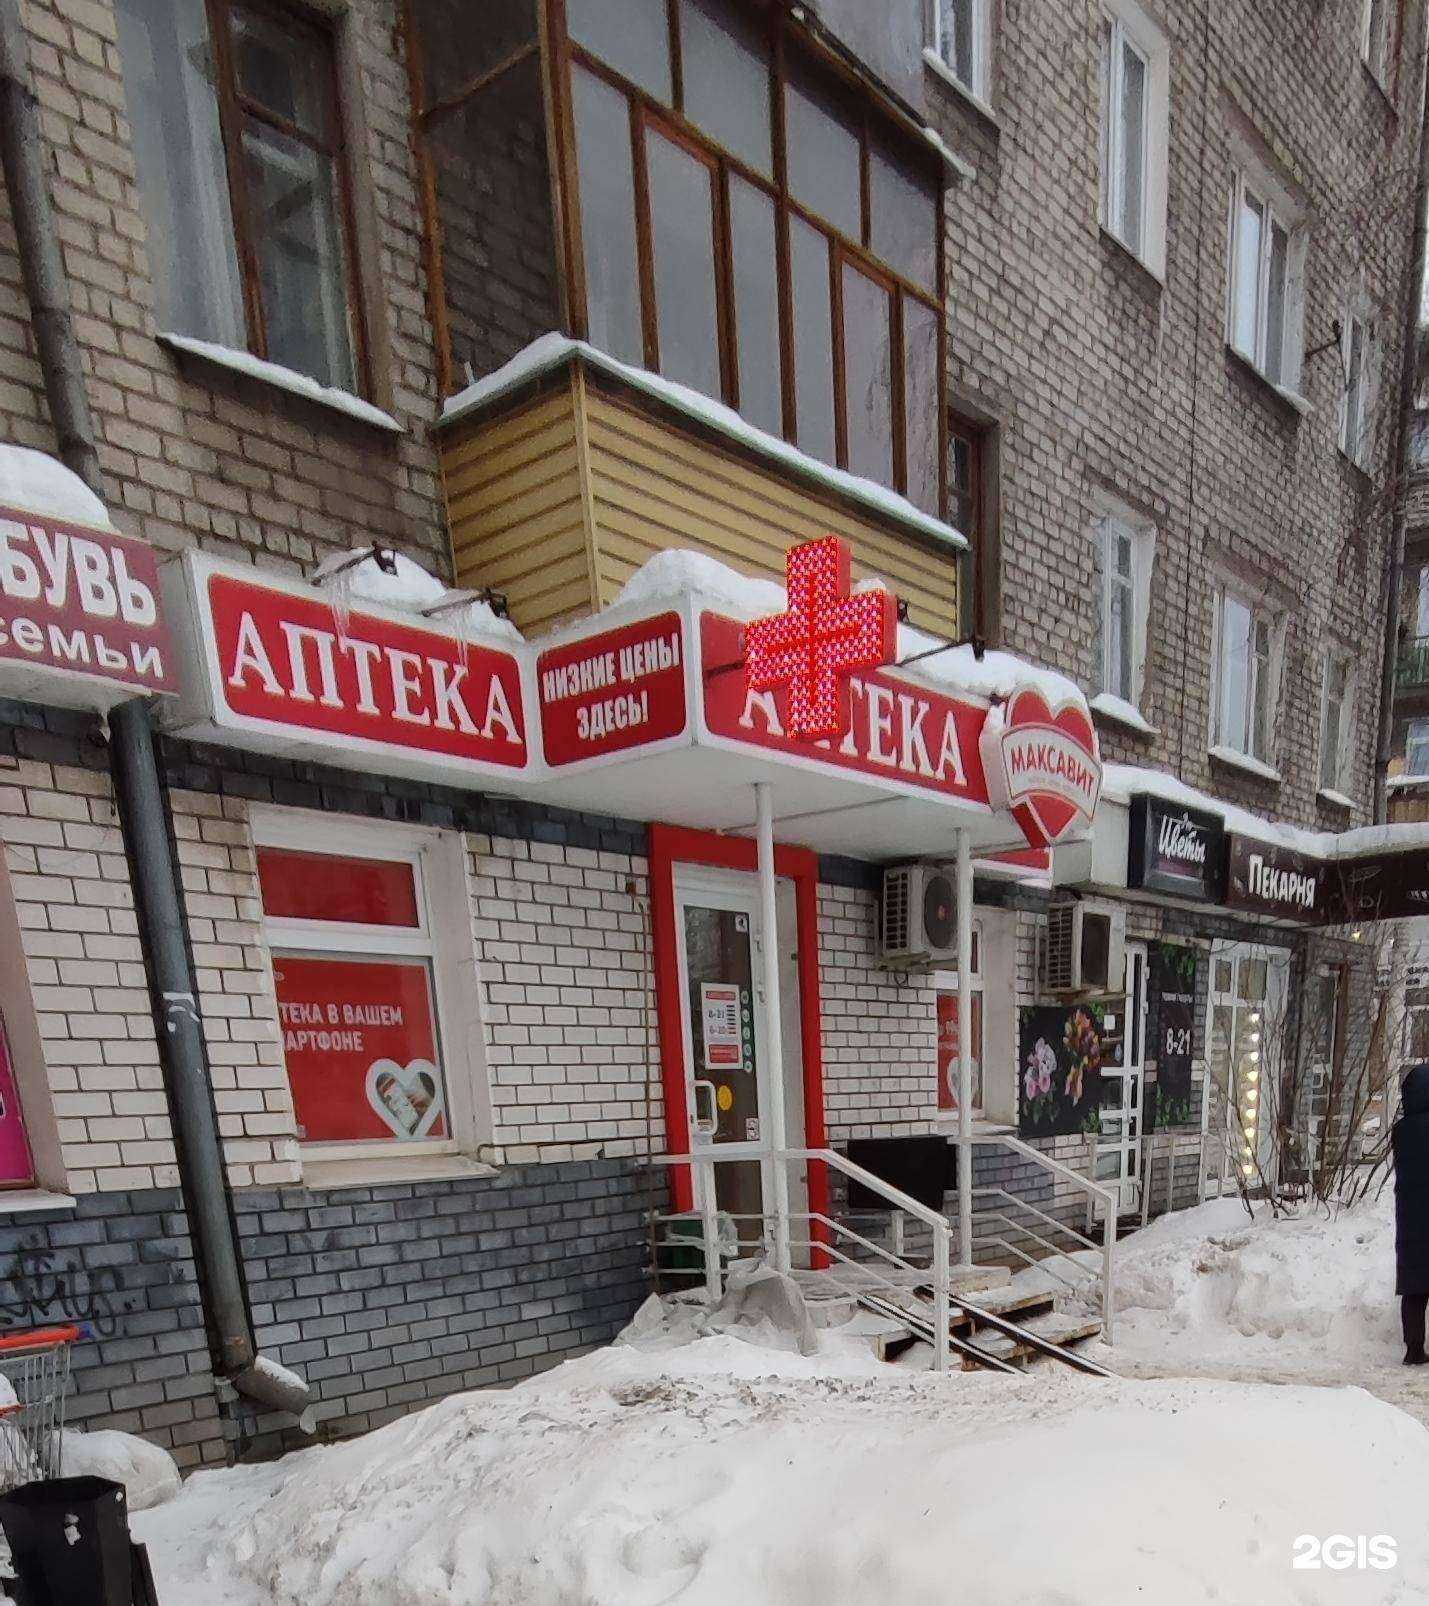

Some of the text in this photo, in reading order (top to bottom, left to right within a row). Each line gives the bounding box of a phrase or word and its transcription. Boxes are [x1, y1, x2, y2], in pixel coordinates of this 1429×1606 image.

[228, 611, 523, 744] АПТЕКА
[542, 632, 680, 703] НИЗКИЕ ЦЕНЫ
[738, 677, 968, 786] АЕКА
[1011, 742, 1095, 797] МАКСАВИТ
[1158, 814, 1206, 864] Цветы
[327, 1003, 339, 1024] В
[342, 1004, 404, 1026] ВАШЕМ
[1166, 1027, 1191, 1055] 8-21
